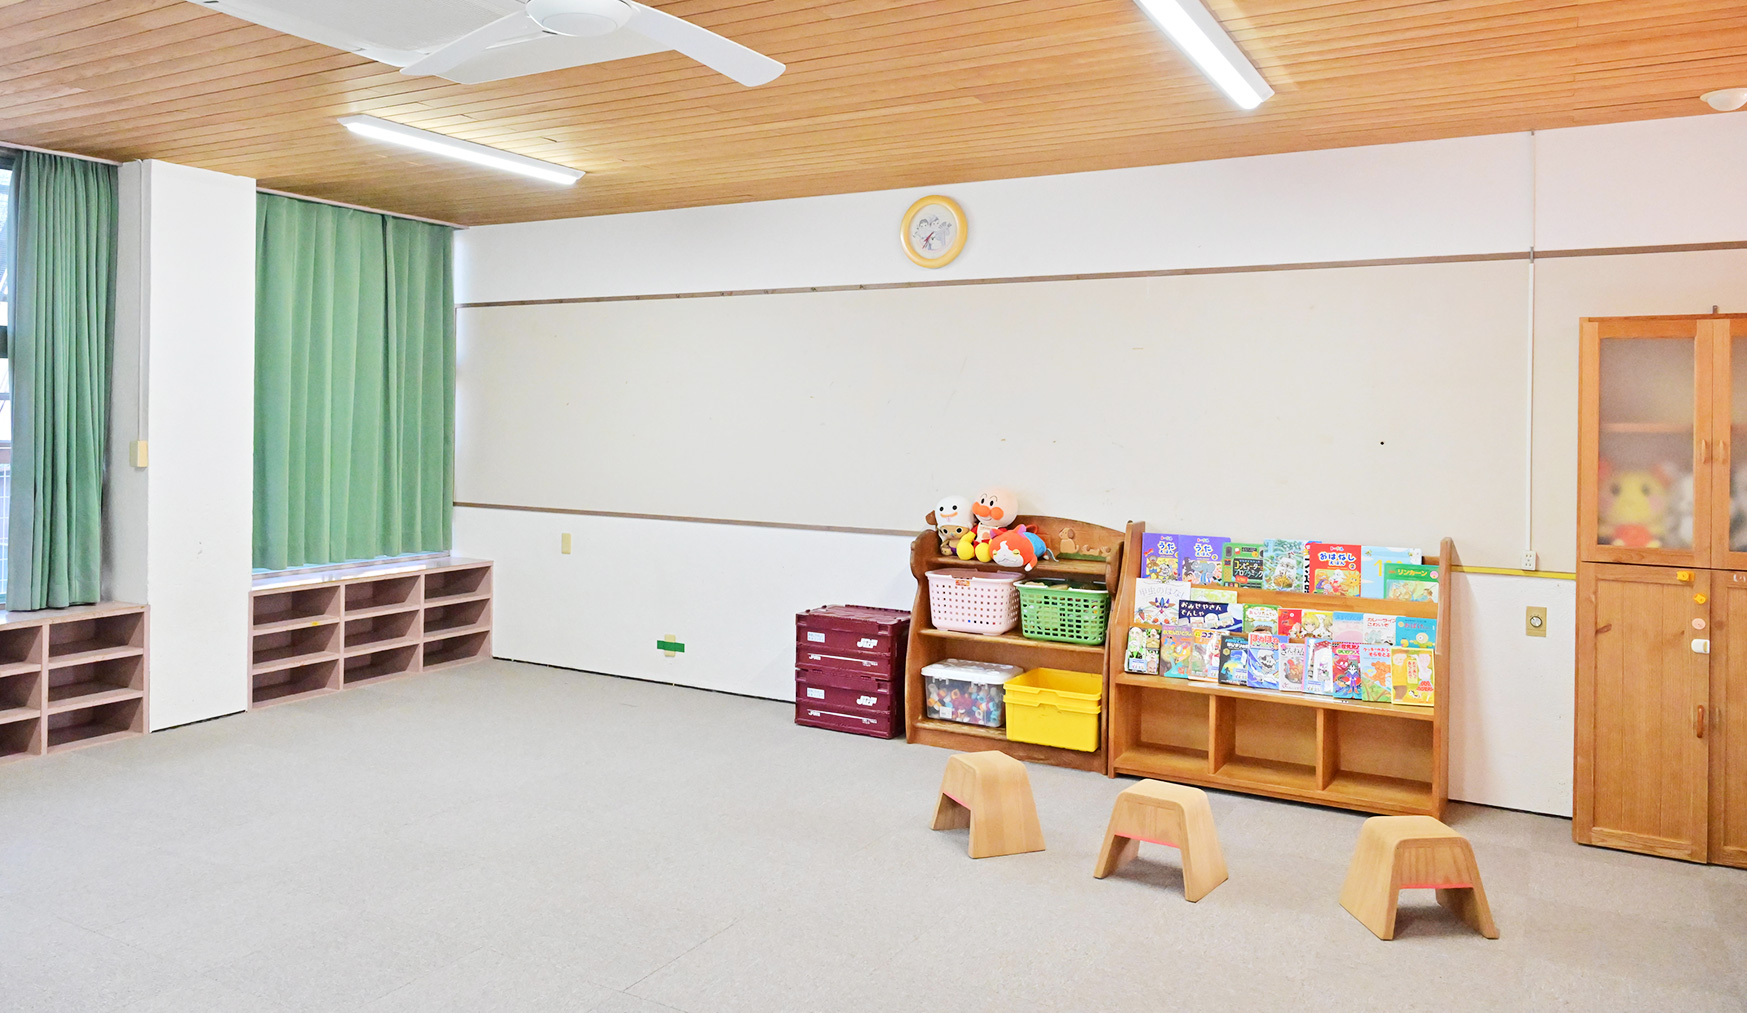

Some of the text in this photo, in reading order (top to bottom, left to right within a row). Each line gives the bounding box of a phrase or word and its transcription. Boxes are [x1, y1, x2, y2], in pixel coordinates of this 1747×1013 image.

[1194, 543, 1213, 553] うた
[1318, 551, 1356, 562] おはなし
[1398, 569, 1428, 577] リンカーン
[1181, 601, 1222, 611] おみせやさん
